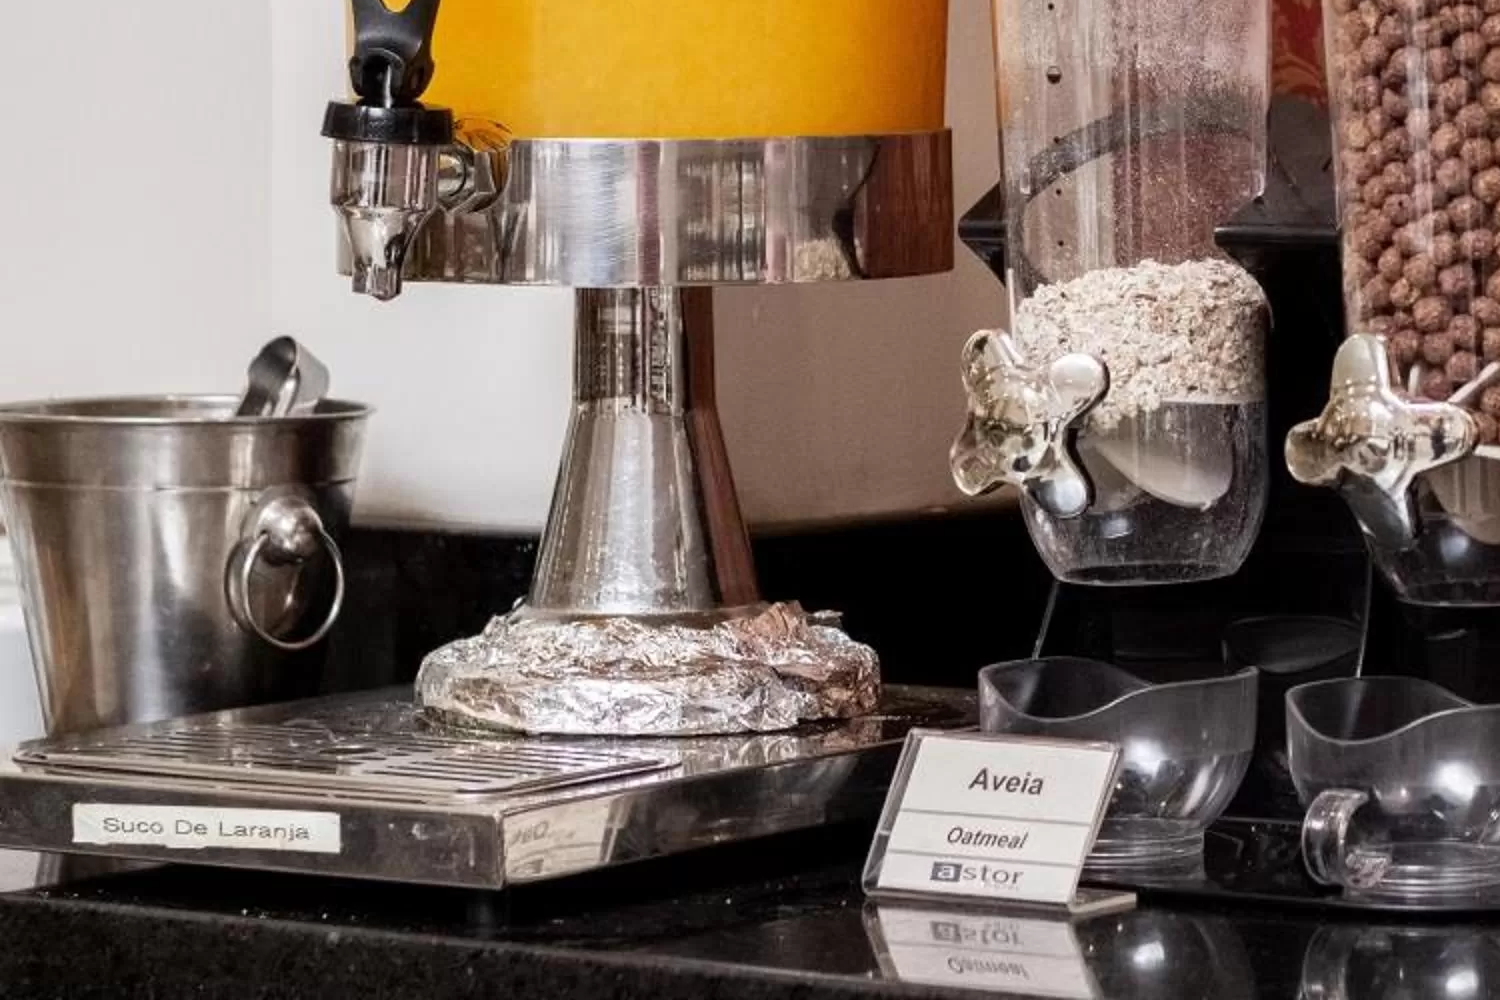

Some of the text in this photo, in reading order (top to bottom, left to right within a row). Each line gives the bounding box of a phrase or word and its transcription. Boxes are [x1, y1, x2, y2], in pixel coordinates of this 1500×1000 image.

[968, 768, 1044, 796] Aveia
[103, 817, 310, 841] Suco De Laranja
[947, 827, 1028, 849] Oatmeal
[931, 862, 1024, 884] astor
